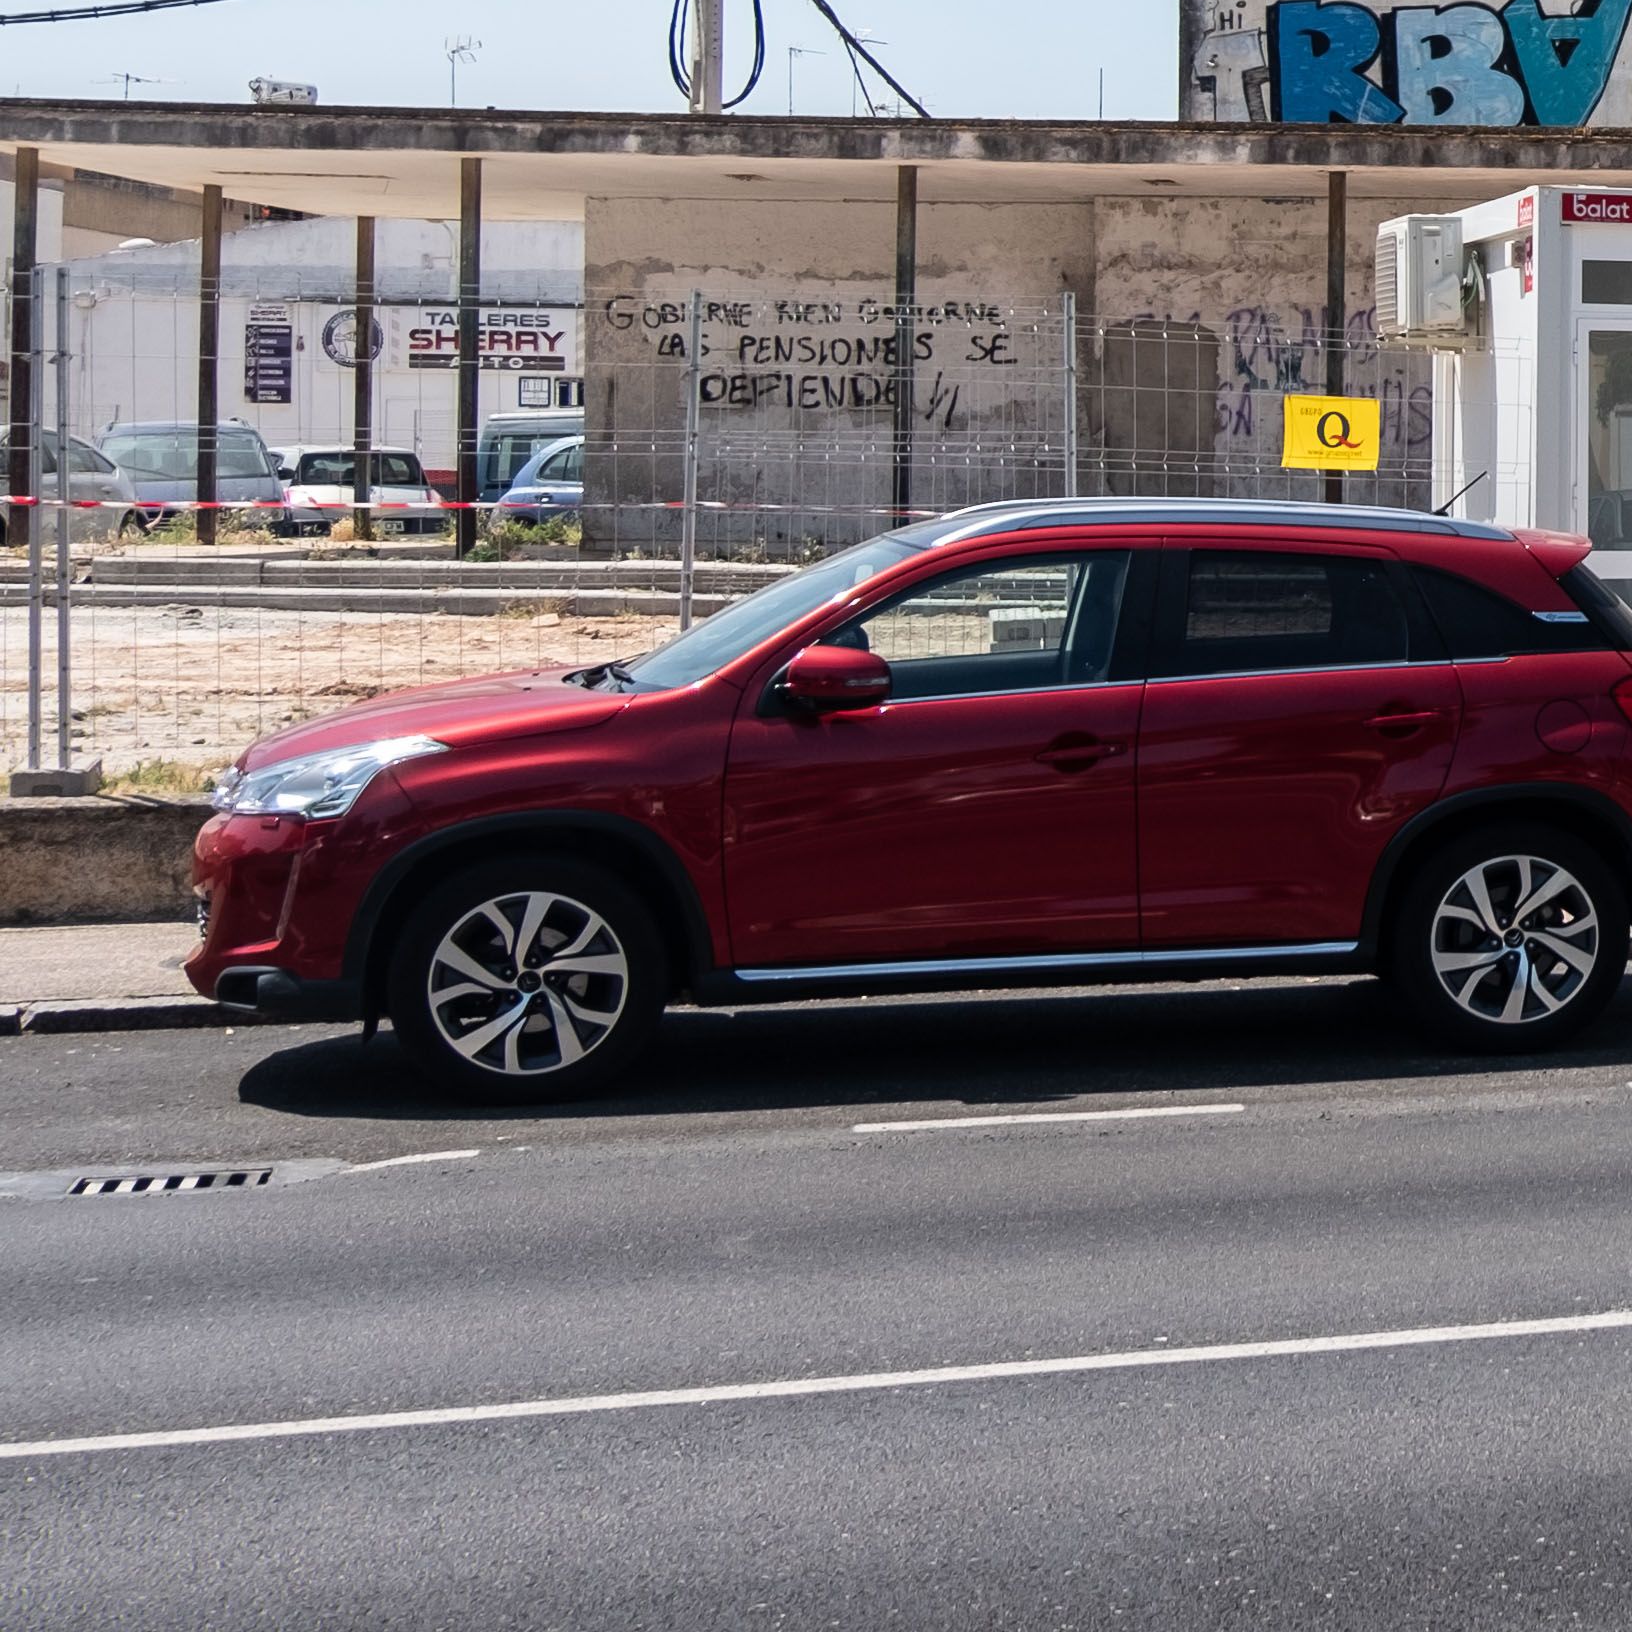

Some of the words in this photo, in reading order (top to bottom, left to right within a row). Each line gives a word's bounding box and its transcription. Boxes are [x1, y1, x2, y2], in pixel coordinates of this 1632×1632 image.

[1573, 193, 1630, 219] balat
[425, 311, 550, 327] TAERES
[965, 333, 1018, 365] SE
[447, 356, 524, 369] ATO
[1316, 411, 1365, 449] Q
